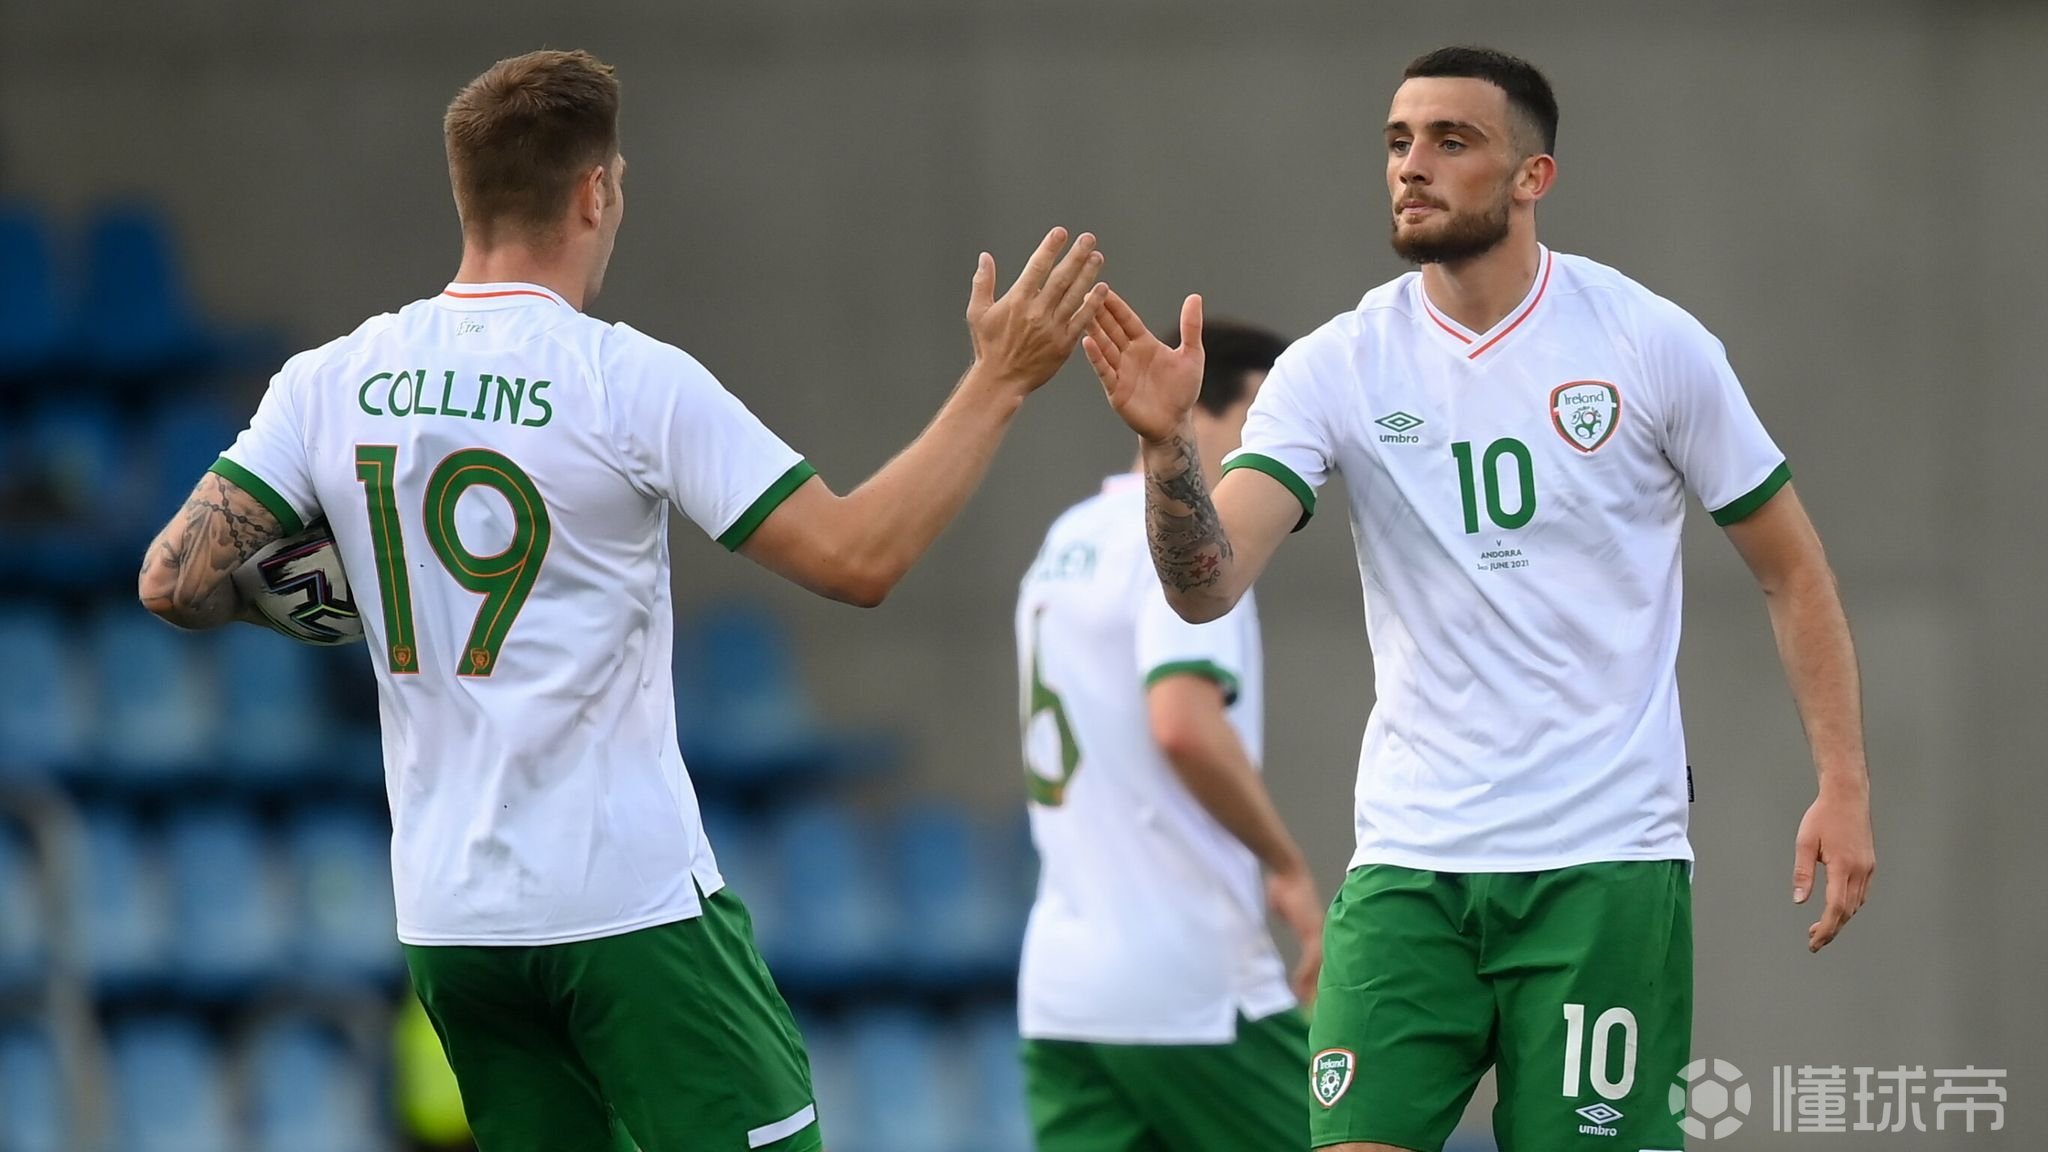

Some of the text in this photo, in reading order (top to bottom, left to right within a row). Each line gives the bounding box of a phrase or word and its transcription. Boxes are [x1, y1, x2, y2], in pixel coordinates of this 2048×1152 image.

[358, 369, 552, 427] COLLINS
[1564, 390, 1605, 405] Ireland
[1379, 433, 1419, 443] umbro
[1450, 437, 1537, 535] 10
[355, 444, 551, 677] 19
[1480, 549, 1522, 559] ANDORRA
[1490, 561, 1509, 571] JUNE
[1510, 559, 1529, 569] 2021
[1562, 1003, 1638, 1100] 10
[1319, 1057, 1346, 1070] Ireland
[1579, 1124, 1617, 1136] umbro
